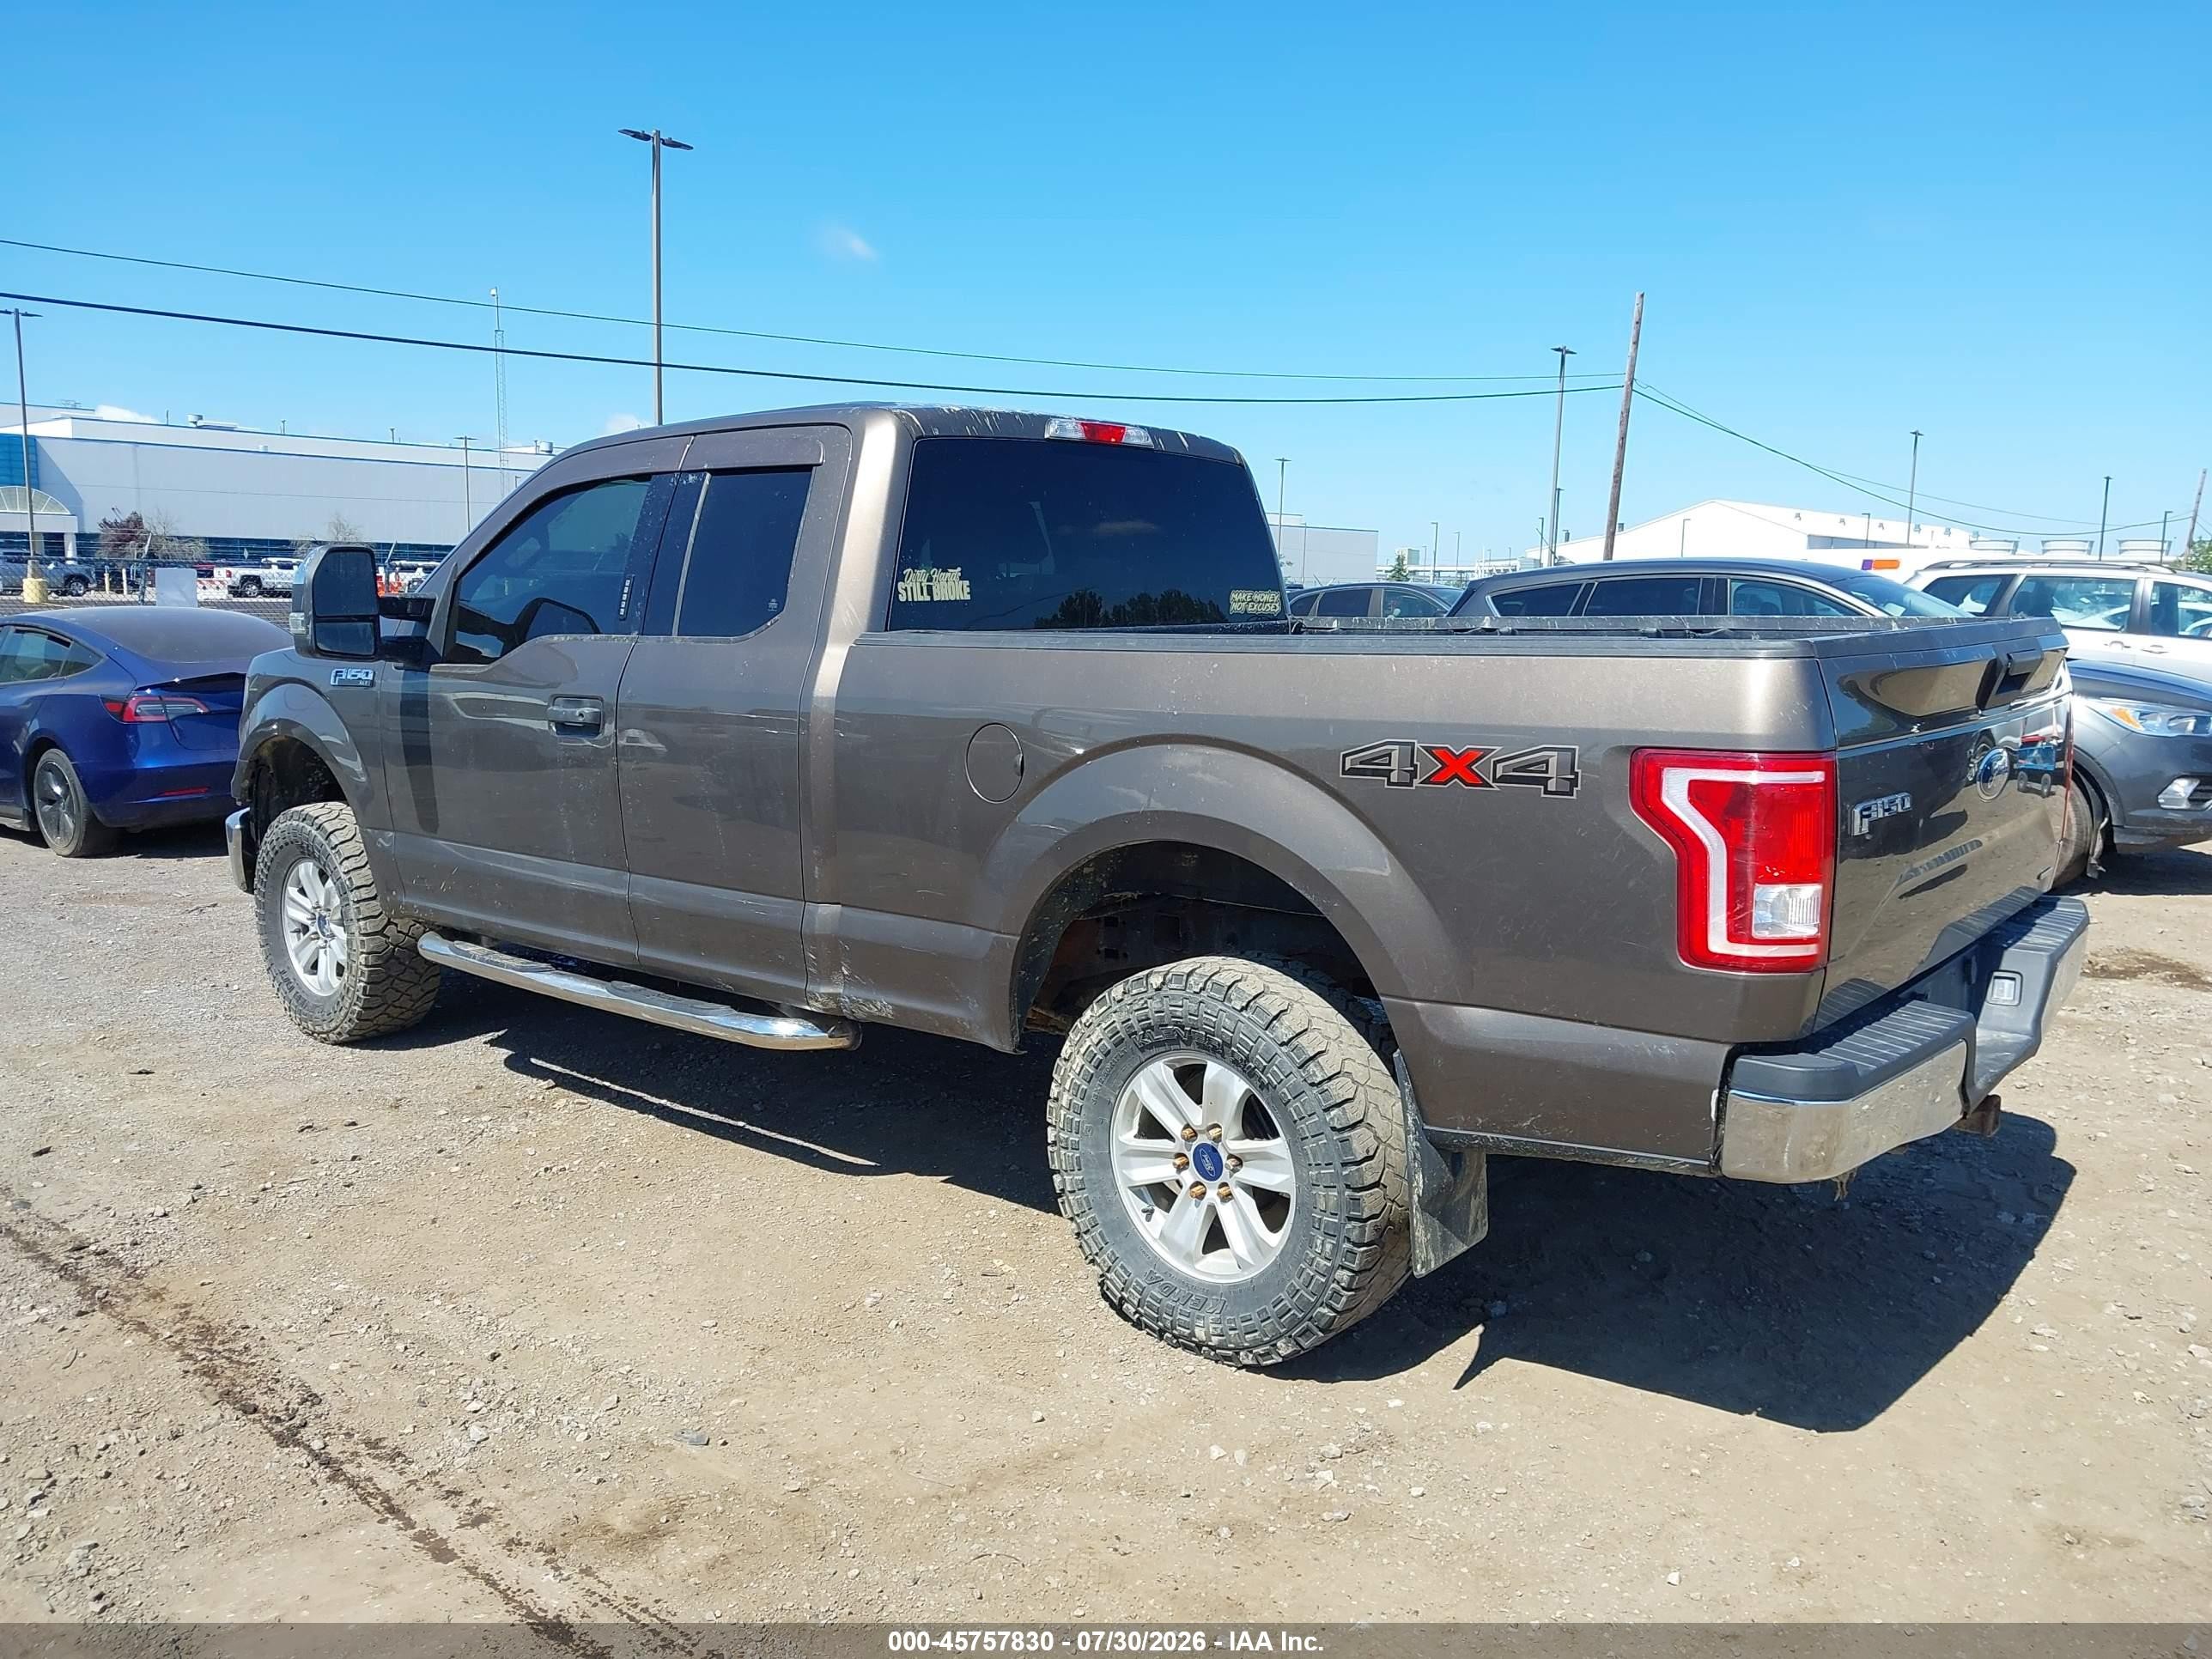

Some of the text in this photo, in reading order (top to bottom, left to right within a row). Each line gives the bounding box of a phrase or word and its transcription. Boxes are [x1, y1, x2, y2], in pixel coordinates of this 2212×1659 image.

[903, 567, 962, 584] Dirty Hands
[897, 580, 971, 602] STILL BROKE
[1231, 592, 1279, 603] MAKE MONEY
[1231, 602, 1280, 613] NOT EXCUSES
[1144, 1269, 1228, 1315] KENDA
